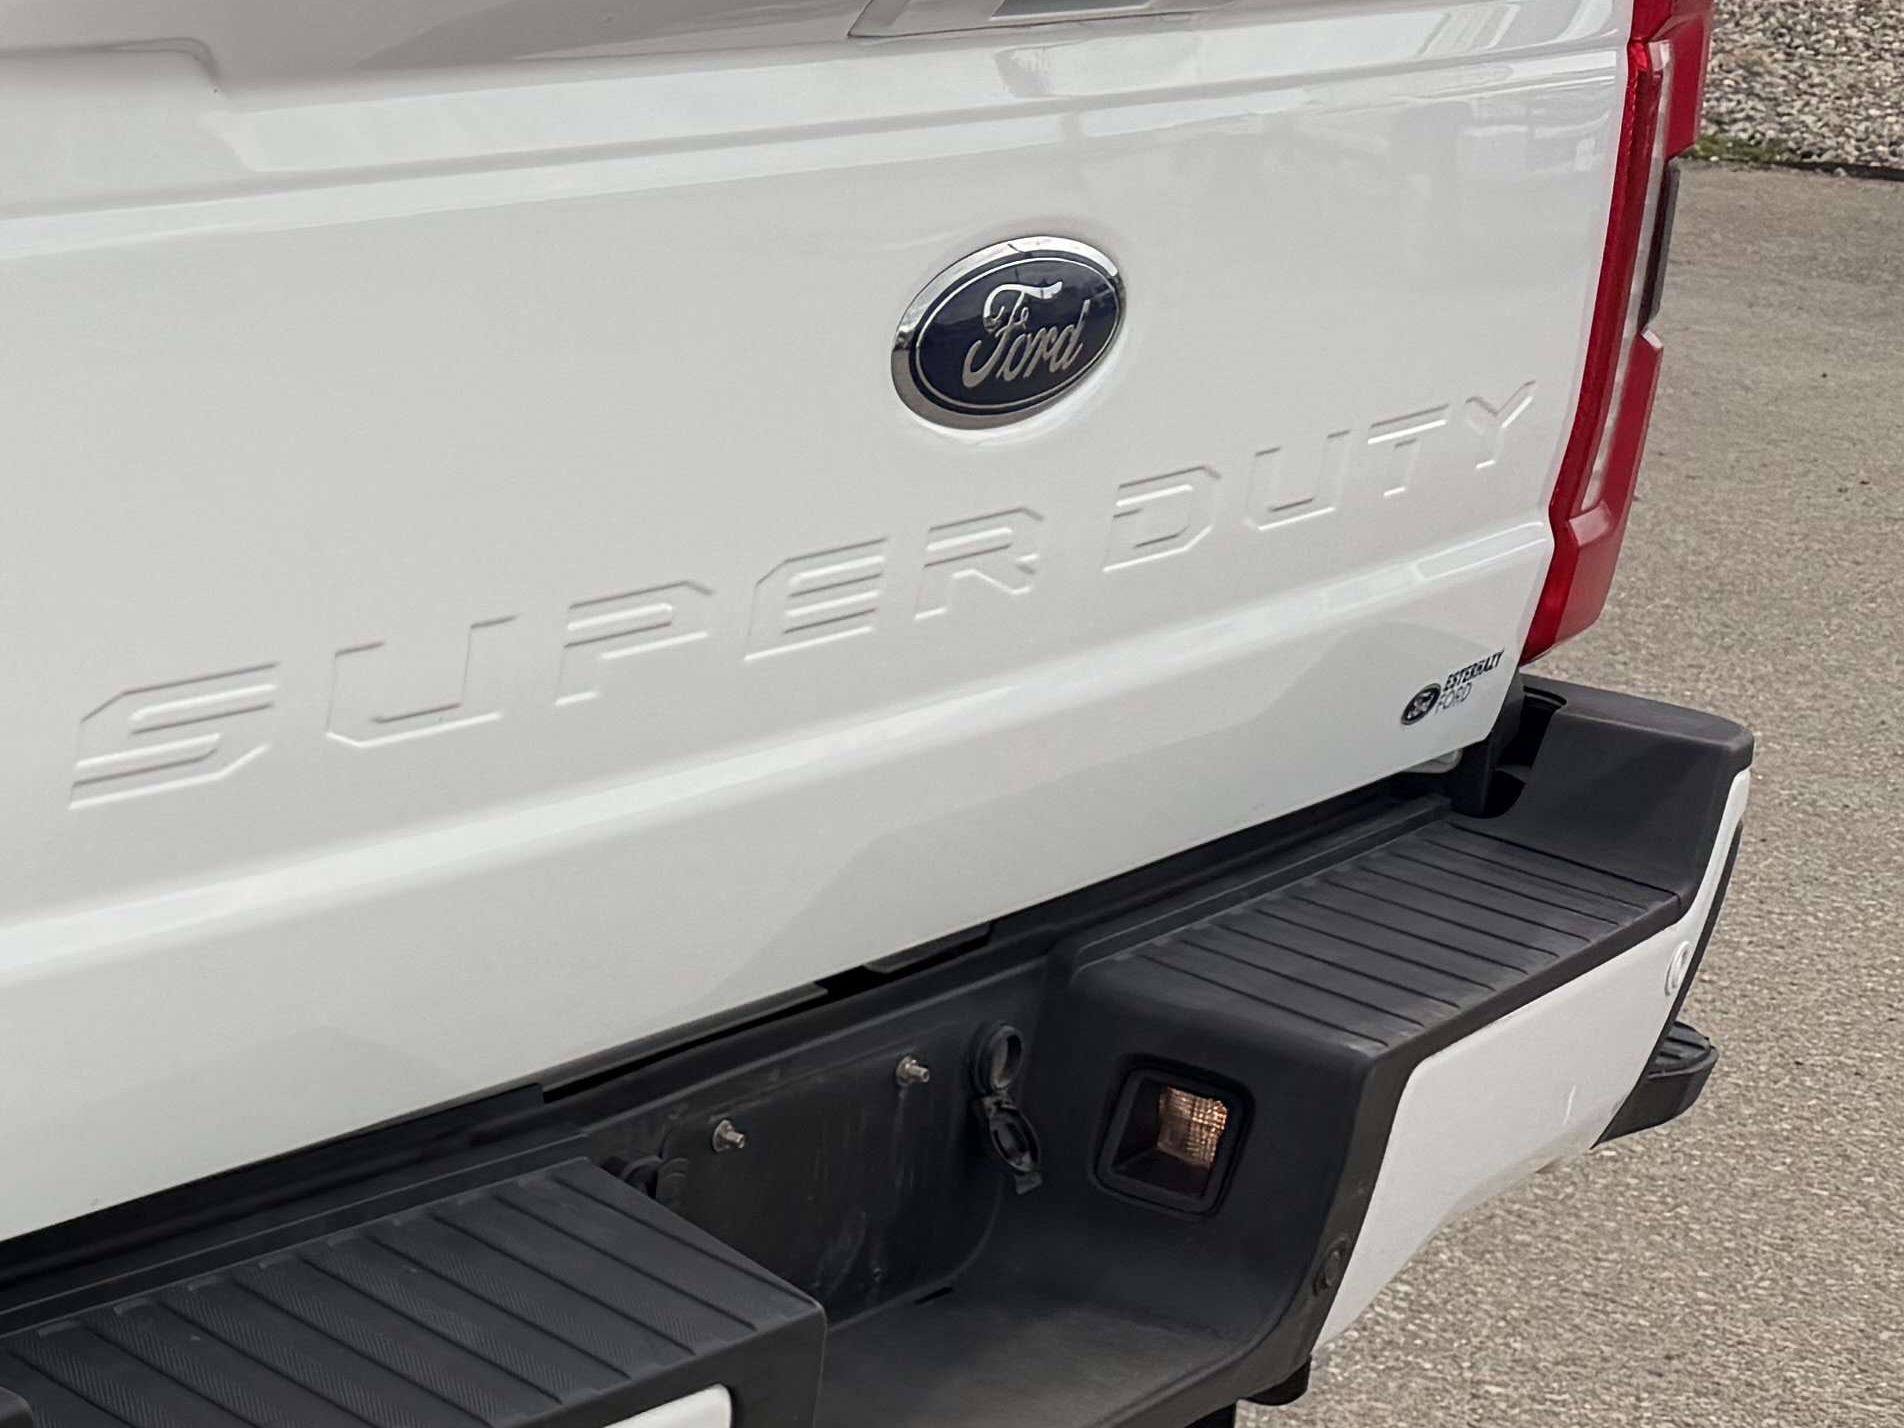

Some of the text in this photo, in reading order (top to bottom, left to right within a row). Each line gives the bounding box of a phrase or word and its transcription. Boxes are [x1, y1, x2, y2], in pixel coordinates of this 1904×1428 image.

[961, 280, 1092, 390] Ford
[67, 379, 1537, 811] SUPER DUTY
[1434, 682, 1473, 715] FORD
[1442, 649, 1505, 692] ESTERHAZY
